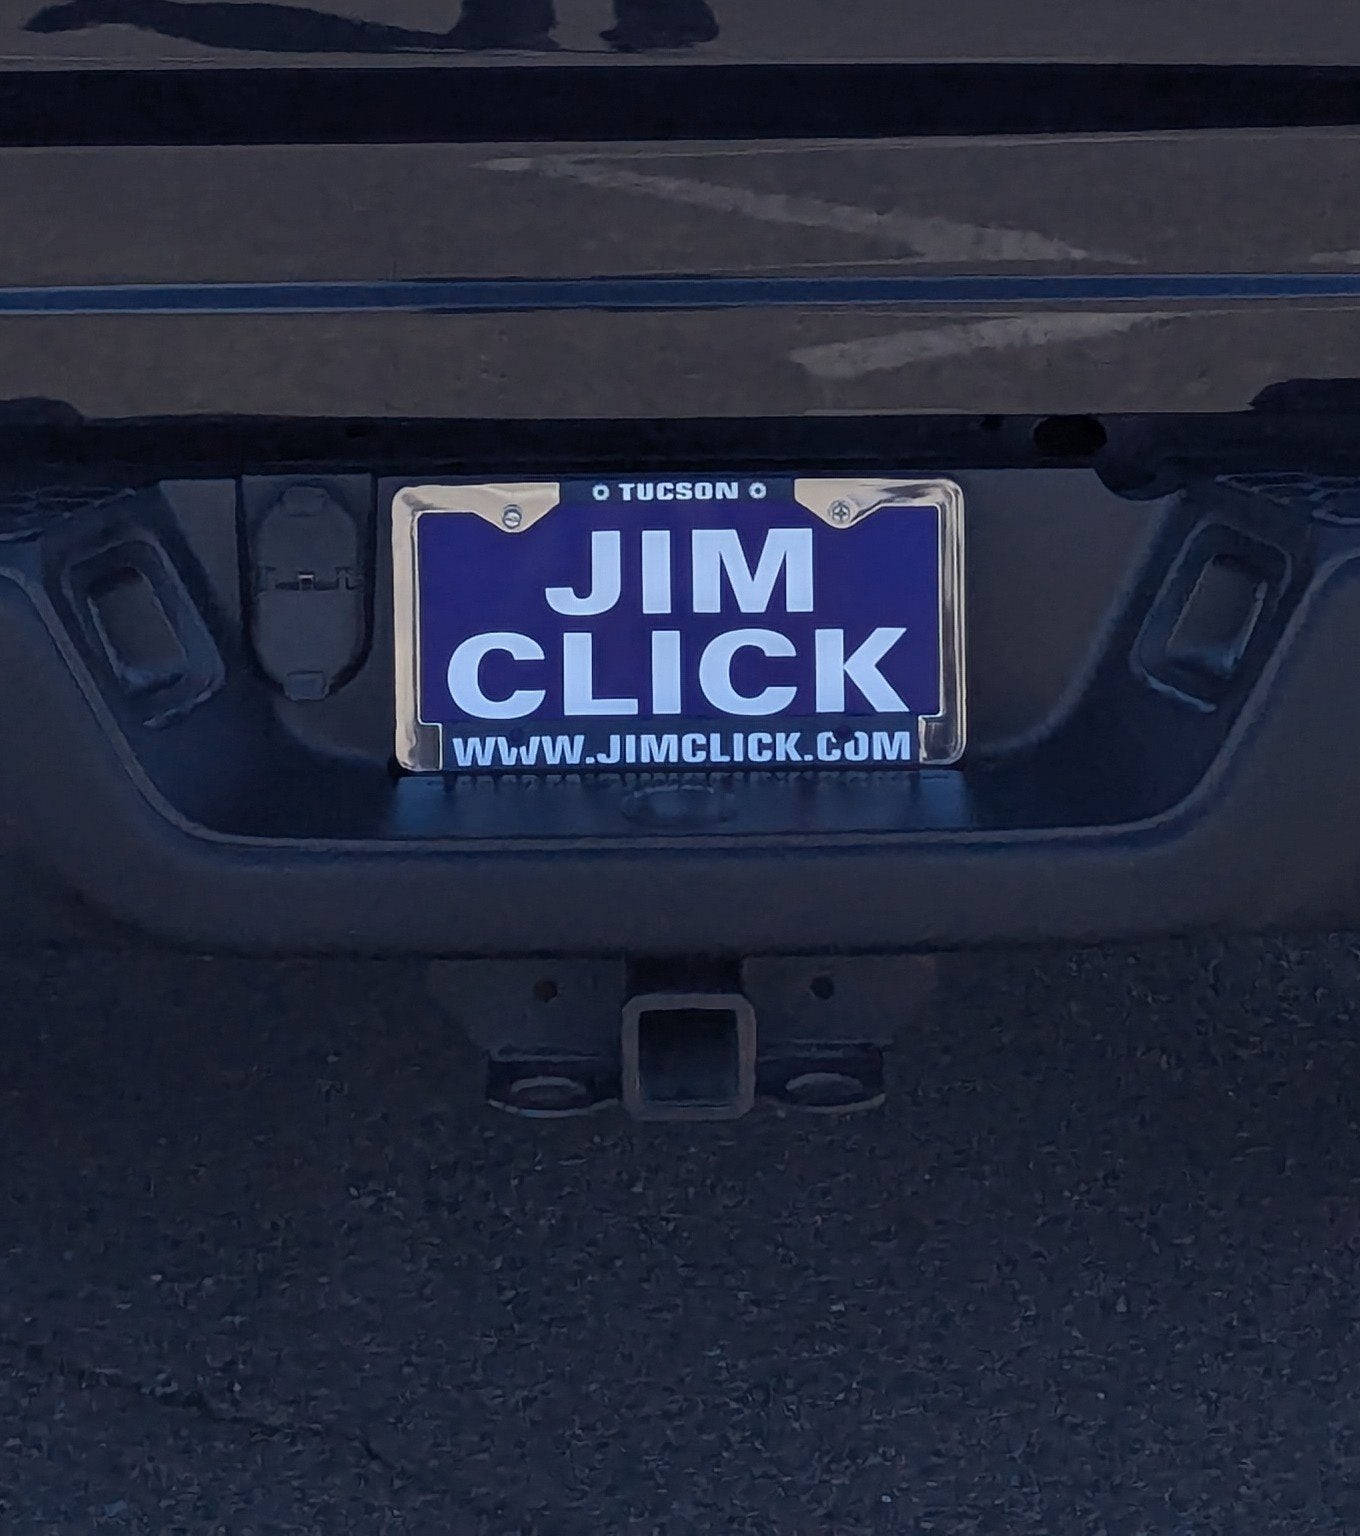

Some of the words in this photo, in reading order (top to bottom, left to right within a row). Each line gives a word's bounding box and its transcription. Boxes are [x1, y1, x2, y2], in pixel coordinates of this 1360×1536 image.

[617, 481, 740, 501] TUCSON
[544, 527, 815, 616] JIM
[446, 626, 910, 720] CLICK
[451, 729, 912, 767] WWW.JIMCLICK.COM
